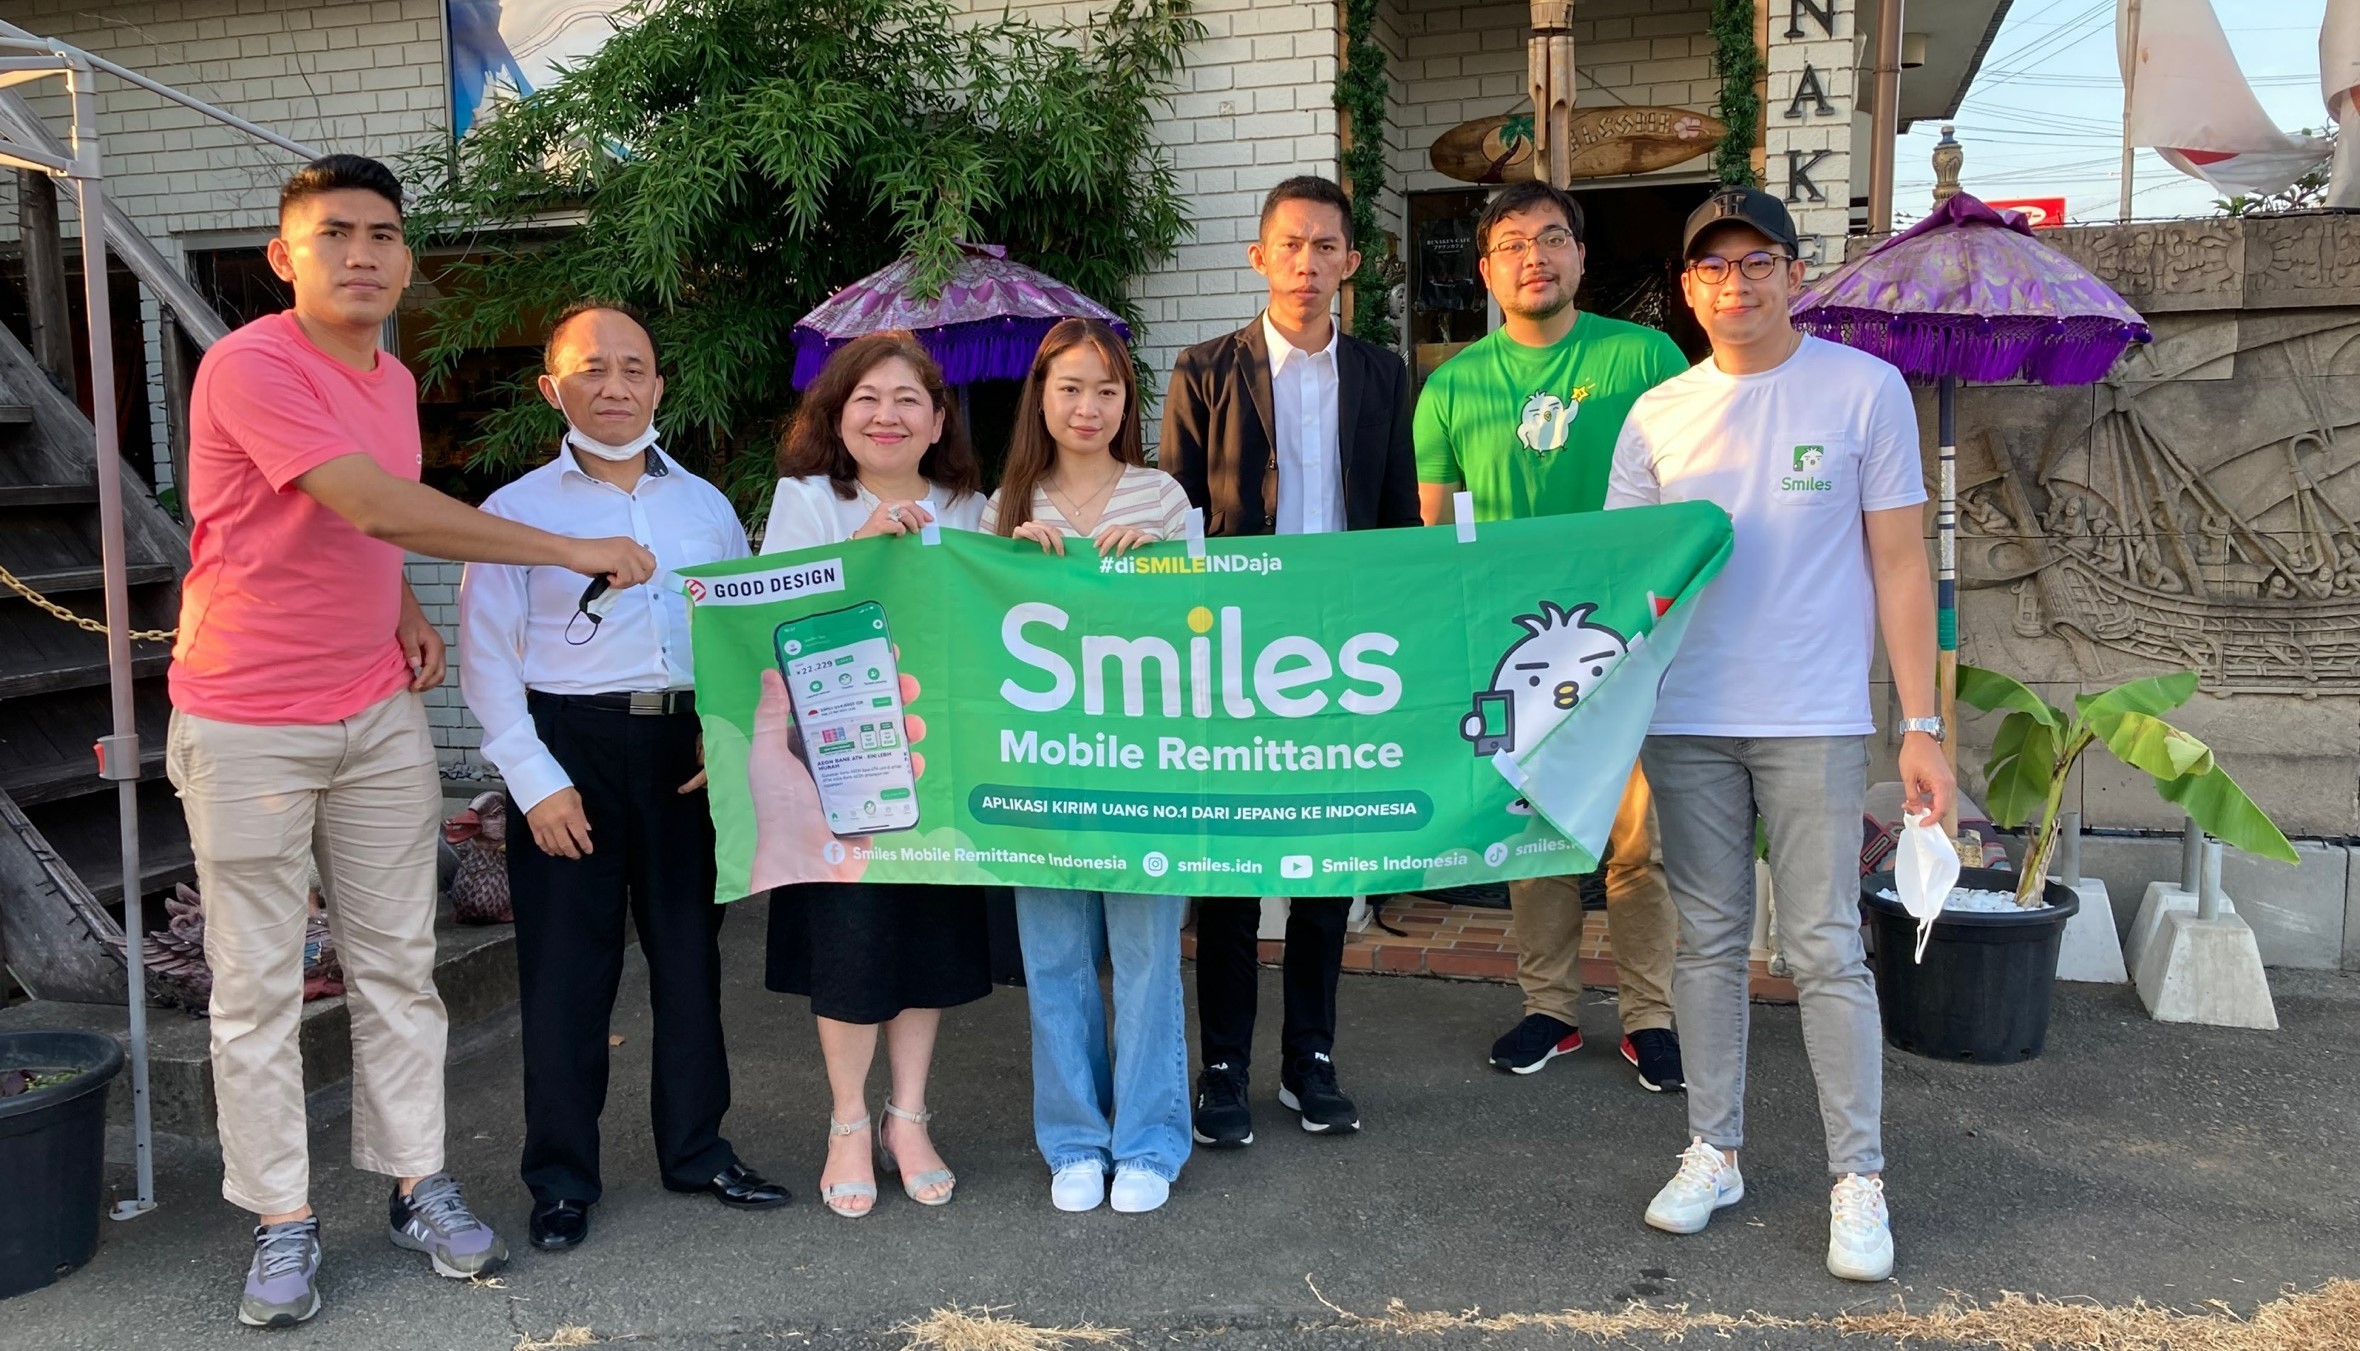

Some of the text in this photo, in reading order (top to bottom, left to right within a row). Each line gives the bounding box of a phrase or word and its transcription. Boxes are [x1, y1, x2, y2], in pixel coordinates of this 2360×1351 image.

[1569, 112, 1673, 152] ELCOME
[1781, 476, 1832, 491] Smiles
[1099, 552, 1283, 576] #diSMILEINDaja
[714, 567, 836, 598] GOOD DESIGN
[1000, 601, 1403, 719] Smiles
[1000, 729, 1404, 771] Mobile Remittance
[982, 796, 1417, 820] APLIKASI KIRIM UANG NO.1 DARI JEPANG KE INDONESIA
[852, 846, 1127, 870] Smiles Mobile Remittance Indonesia
[1177, 857, 1263, 874] smiles.idn
[1321, 852, 1468, 873] Smiles Indonesia
